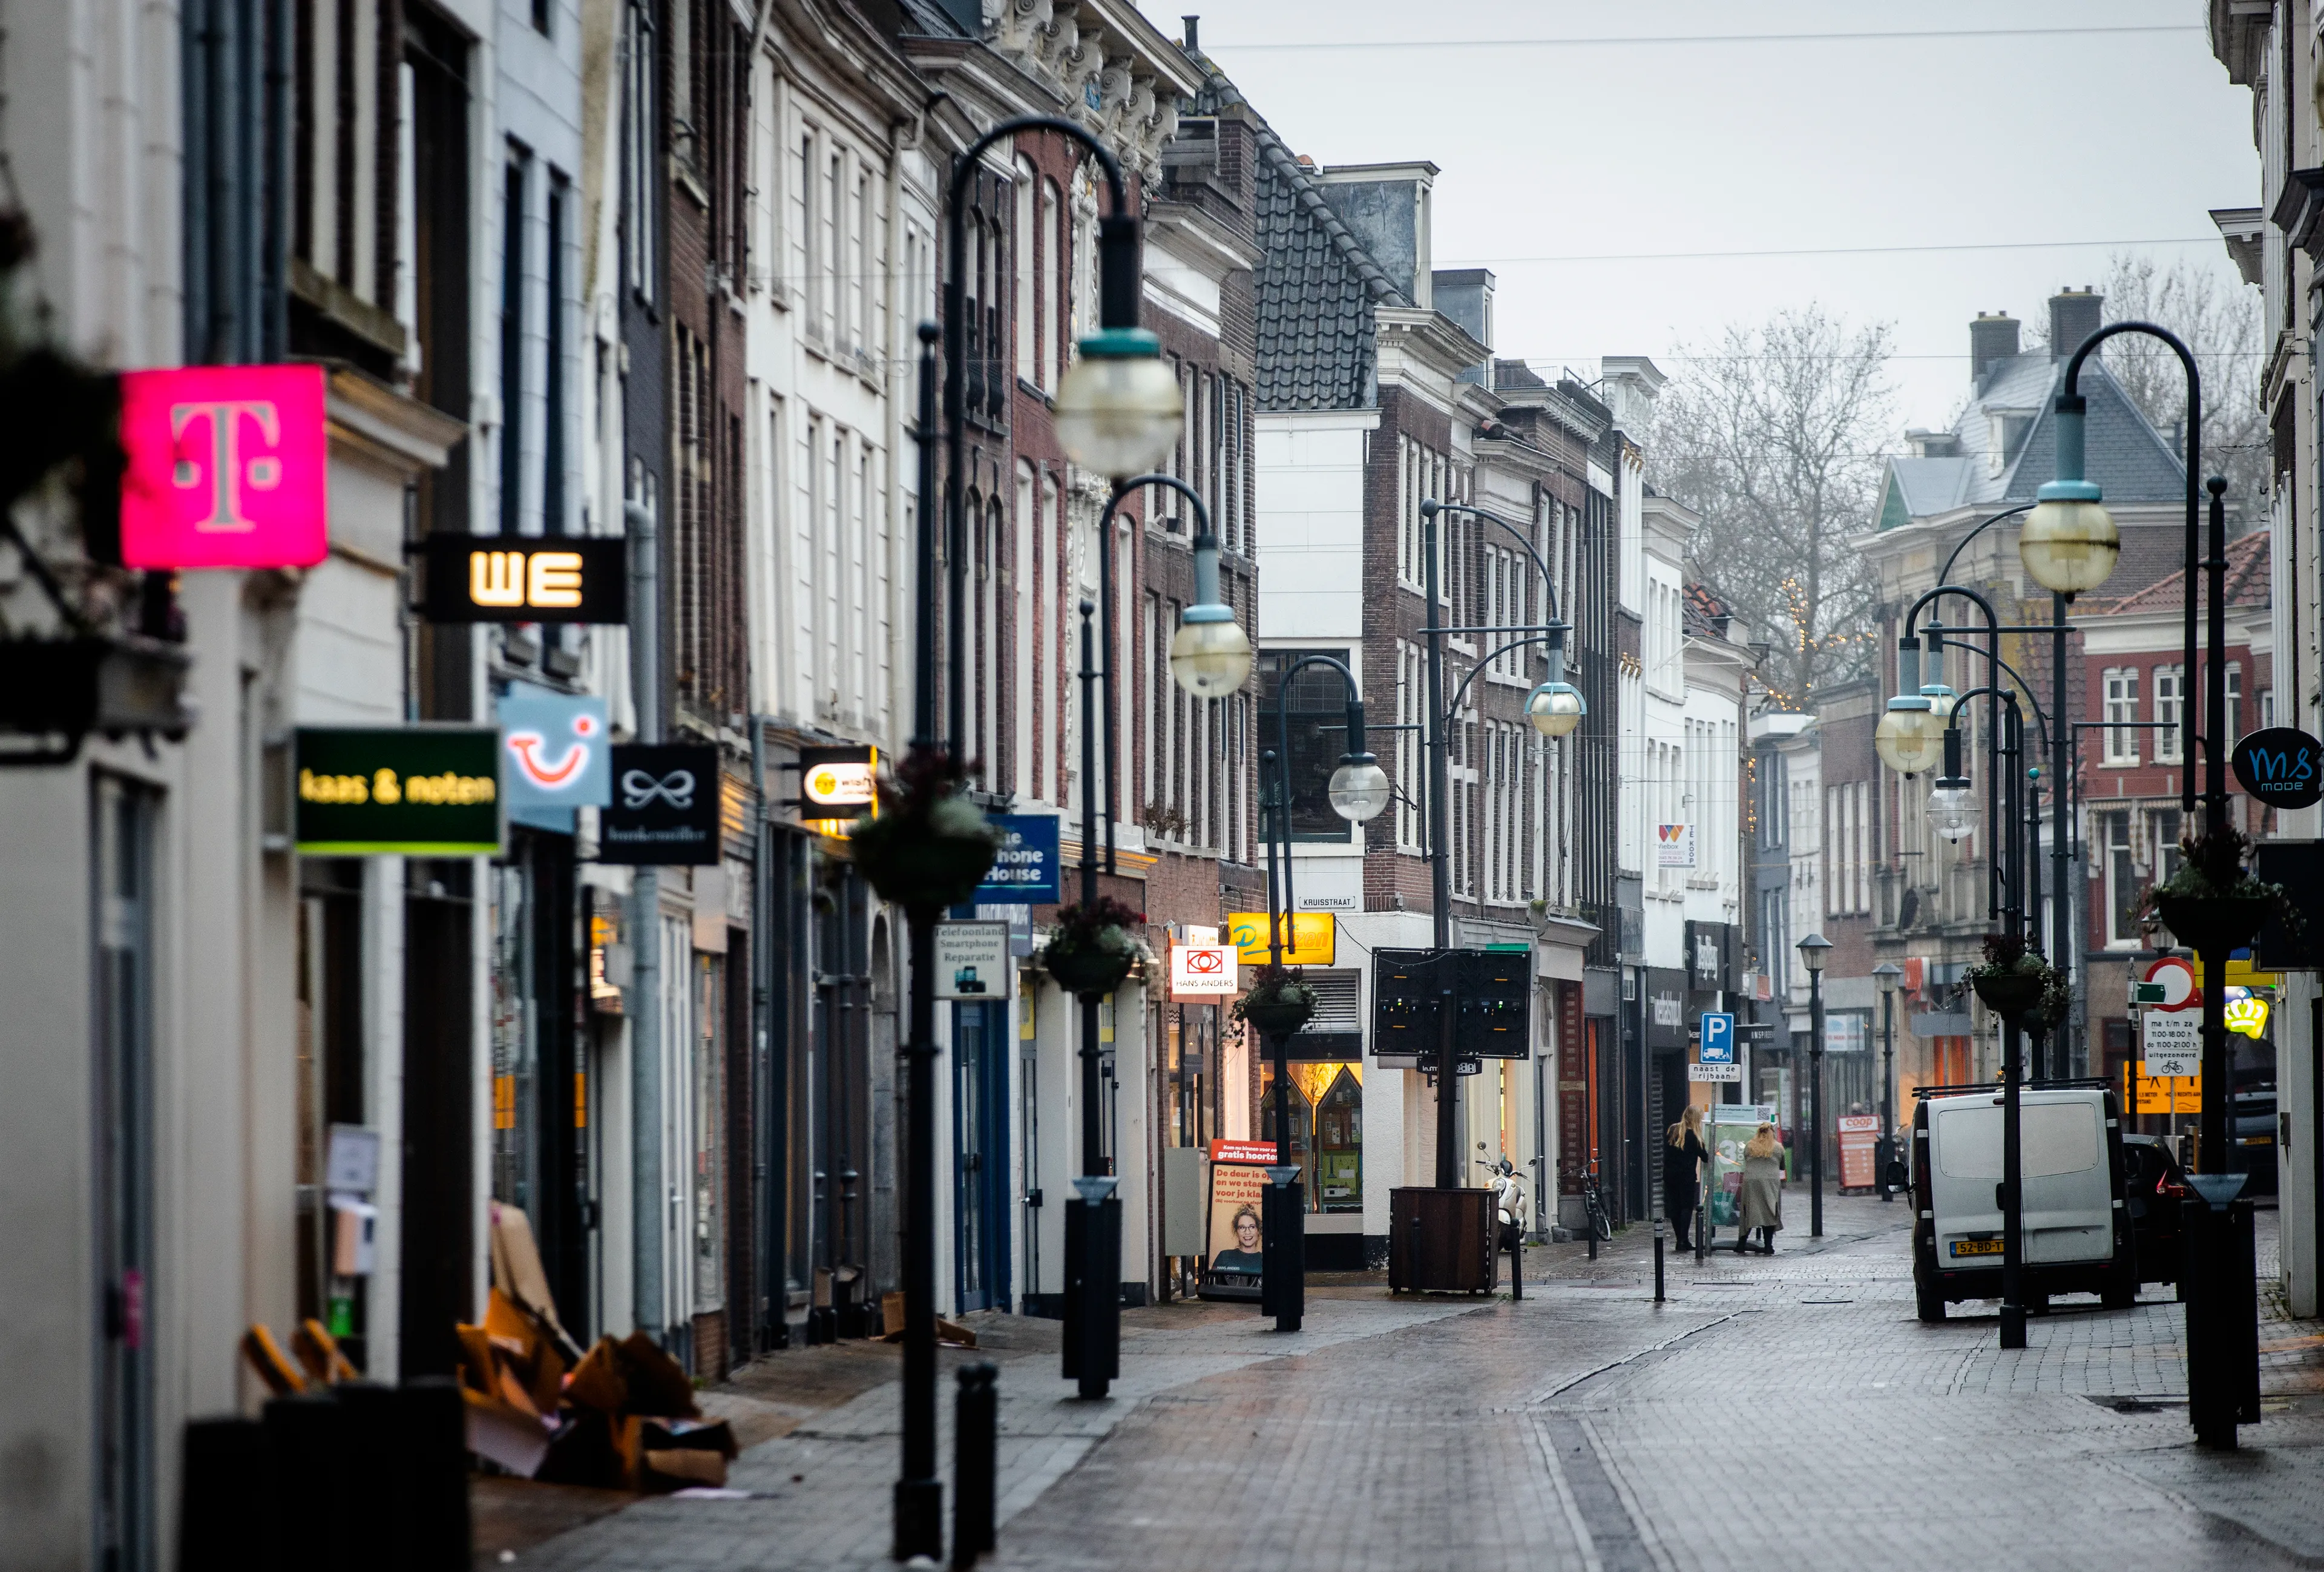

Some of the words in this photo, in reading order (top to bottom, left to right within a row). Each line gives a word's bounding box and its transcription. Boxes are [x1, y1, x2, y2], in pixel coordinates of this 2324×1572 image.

[469, 551, 583, 608] WE
[996, 847, 1044, 863] hone
[1233, 924, 1329, 947] D-rezen
[940, 939, 999, 949] Smartphone
[945, 953, 996, 963] Reparatie
[1708, 1018, 1727, 1042] P
[1846, 1118, 1873, 1127] coop
[1246, 1151, 1278, 1160] hoorte
[1236, 1189, 1245, 1198] je
[1960, 1241, 2004, 1252] 52-BD-T
